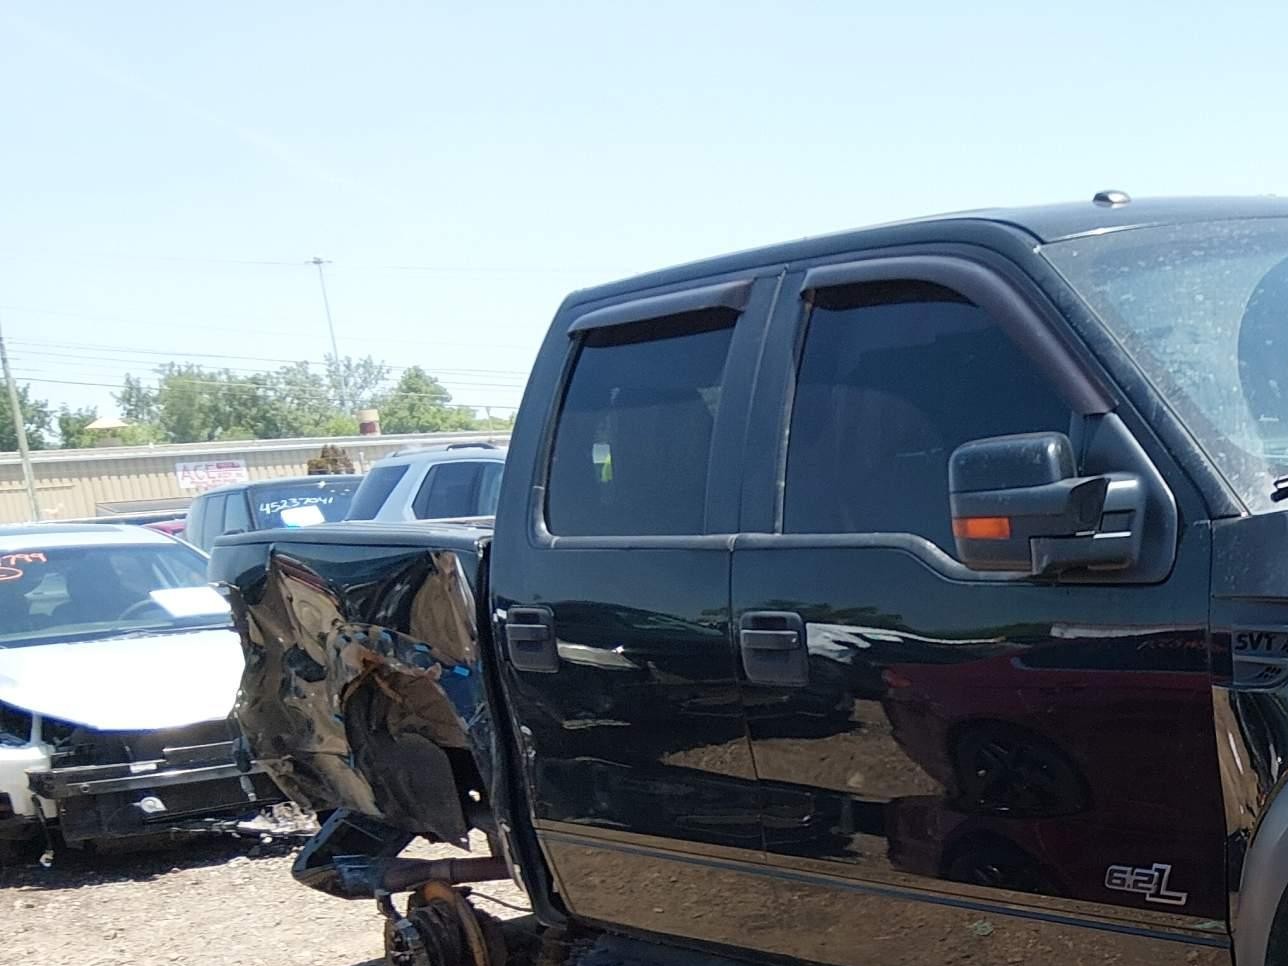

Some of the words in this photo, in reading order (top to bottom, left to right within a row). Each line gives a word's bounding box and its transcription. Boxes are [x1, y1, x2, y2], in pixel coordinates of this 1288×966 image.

[0, 552, 47, 565] 799
[1235, 633, 1276, 651] SVT
[1104, 863, 1188, 906] 6.2L
